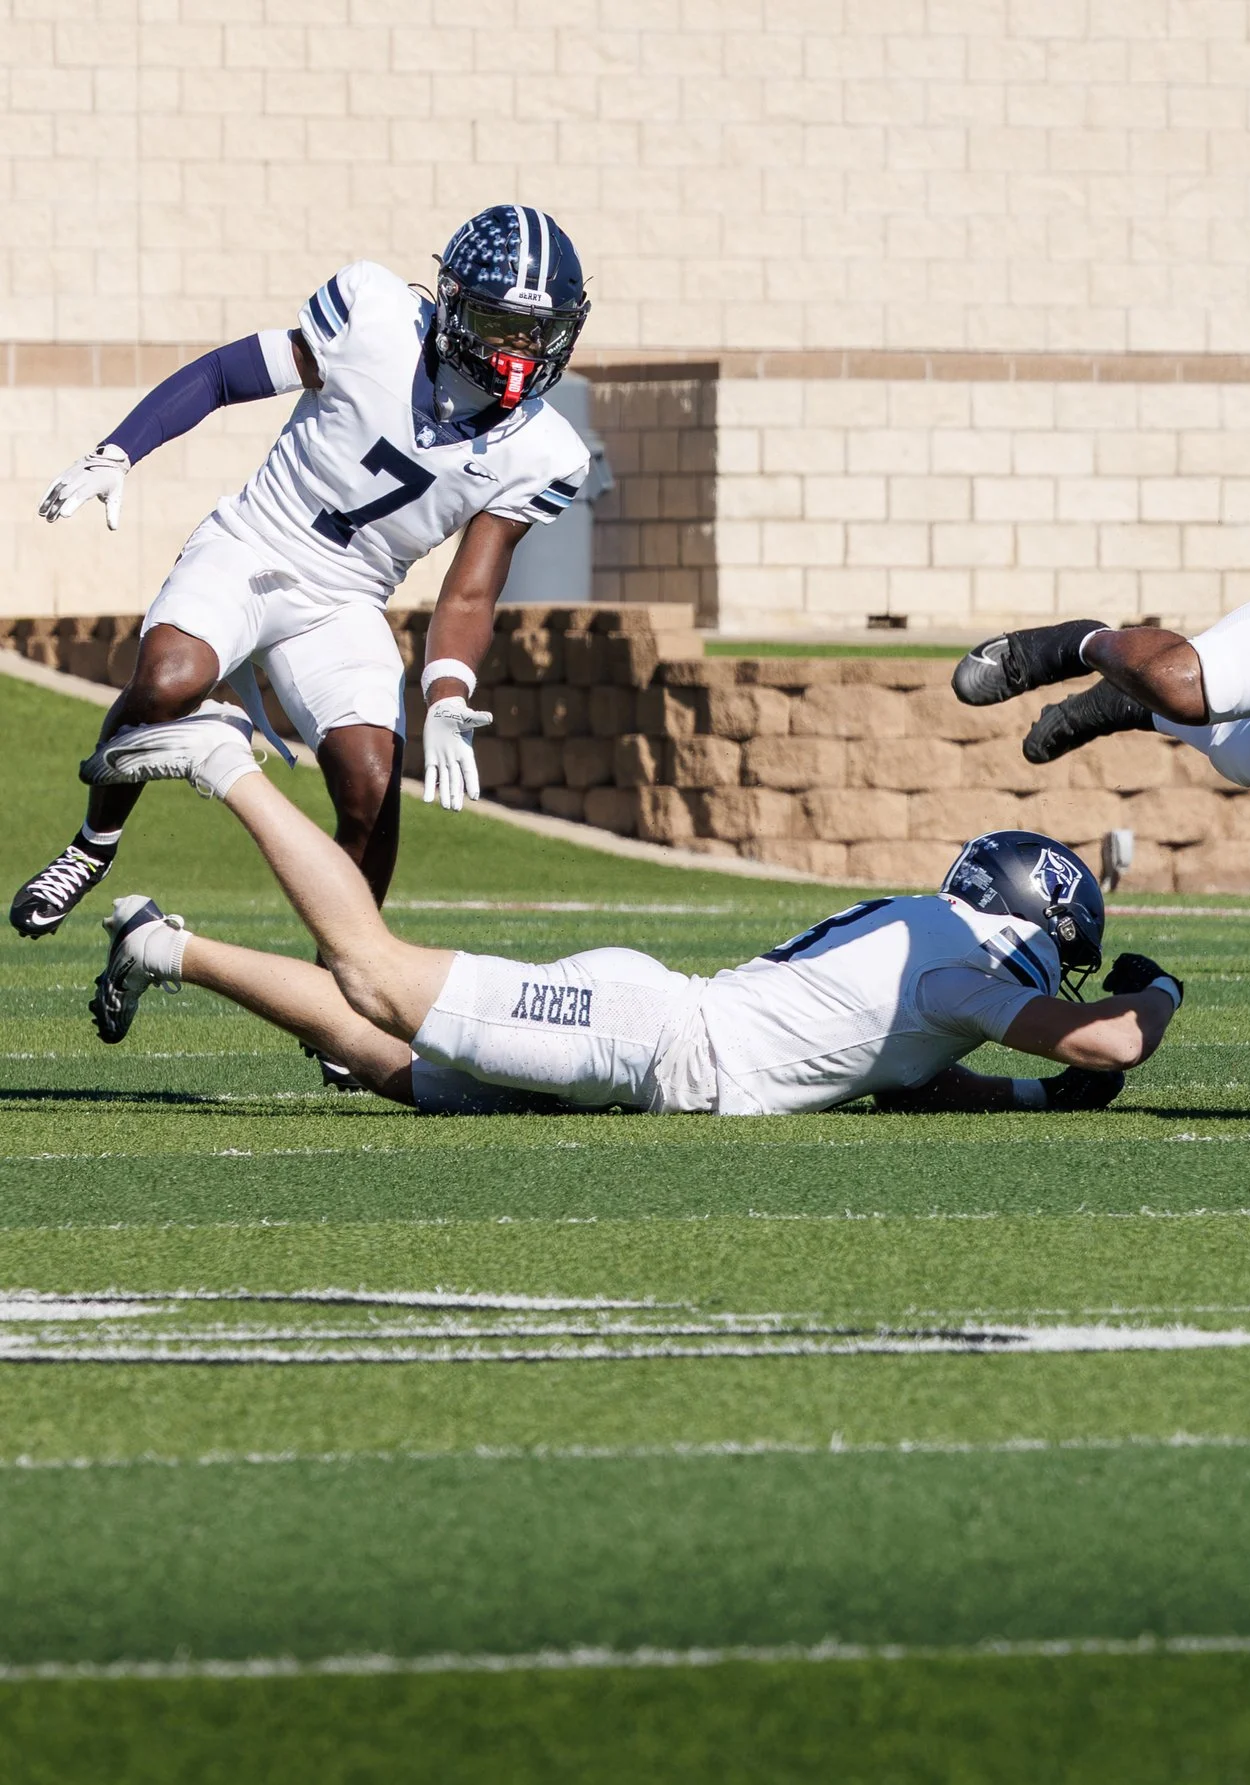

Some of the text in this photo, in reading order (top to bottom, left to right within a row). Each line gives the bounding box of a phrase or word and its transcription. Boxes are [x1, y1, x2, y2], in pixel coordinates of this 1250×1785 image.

[518, 292, 542, 302] BERRY
[311, 436, 437, 549] 7
[511, 982, 592, 1027] BERRY
